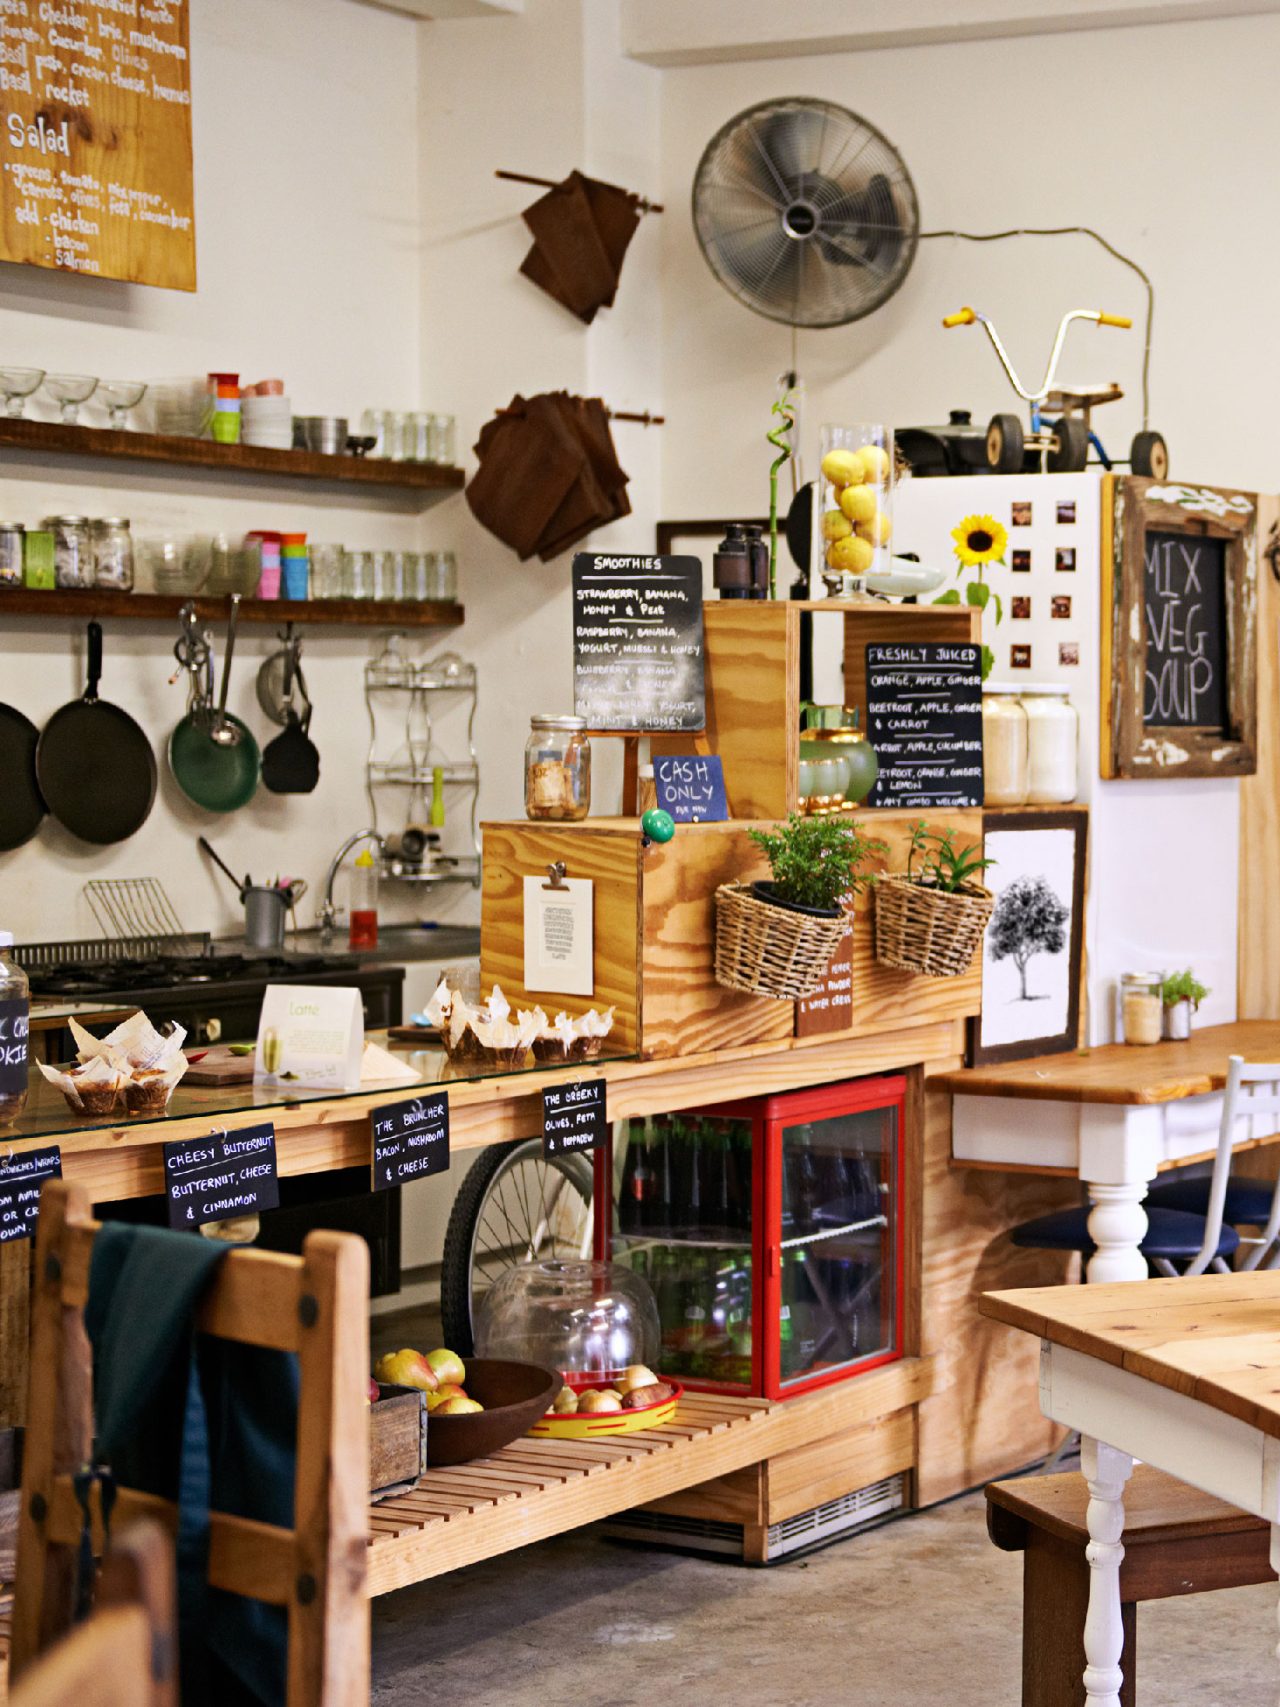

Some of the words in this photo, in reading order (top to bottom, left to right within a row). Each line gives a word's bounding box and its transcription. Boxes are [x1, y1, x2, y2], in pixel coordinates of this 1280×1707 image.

[45, 79, 90, 107] rocket
[7, 113, 70, 156] Salad
[49, 207, 99, 235] chicken
[53, 227, 89, 252] bacon
[594, 556, 661, 570] SMOOTHIES
[1144, 540, 1202, 598] MIX
[1146, 600, 1209, 657] VEG
[868, 647, 927, 661] FRESHLY
[936, 648, 976, 661] JUICED
[887, 719, 929, 730] CARROT
[873, 743, 907, 755] ARROT,
[660, 761, 708, 783] CASH
[875, 768, 915, 779] EETROOT,
[665, 785, 713, 802] ONLY
[889, 780, 922, 791] LEMON
[545, 1094, 560, 1106] THE
[375, 1120, 393, 1135] THE
[403, 1104, 444, 1126] BRUNCHER
[408, 1128, 444, 1147] MUSHROOM
[168, 1148, 215, 1168] CHEESY
[223, 1136, 273, 1155] BUTTERNUT
[398, 1157, 429, 1176] CHEESE
[171, 1173, 239, 1198] BUTTERNUT,
[240, 1164, 272, 1179] CHEESE
[203, 1193, 257, 1213] CINNAMON
